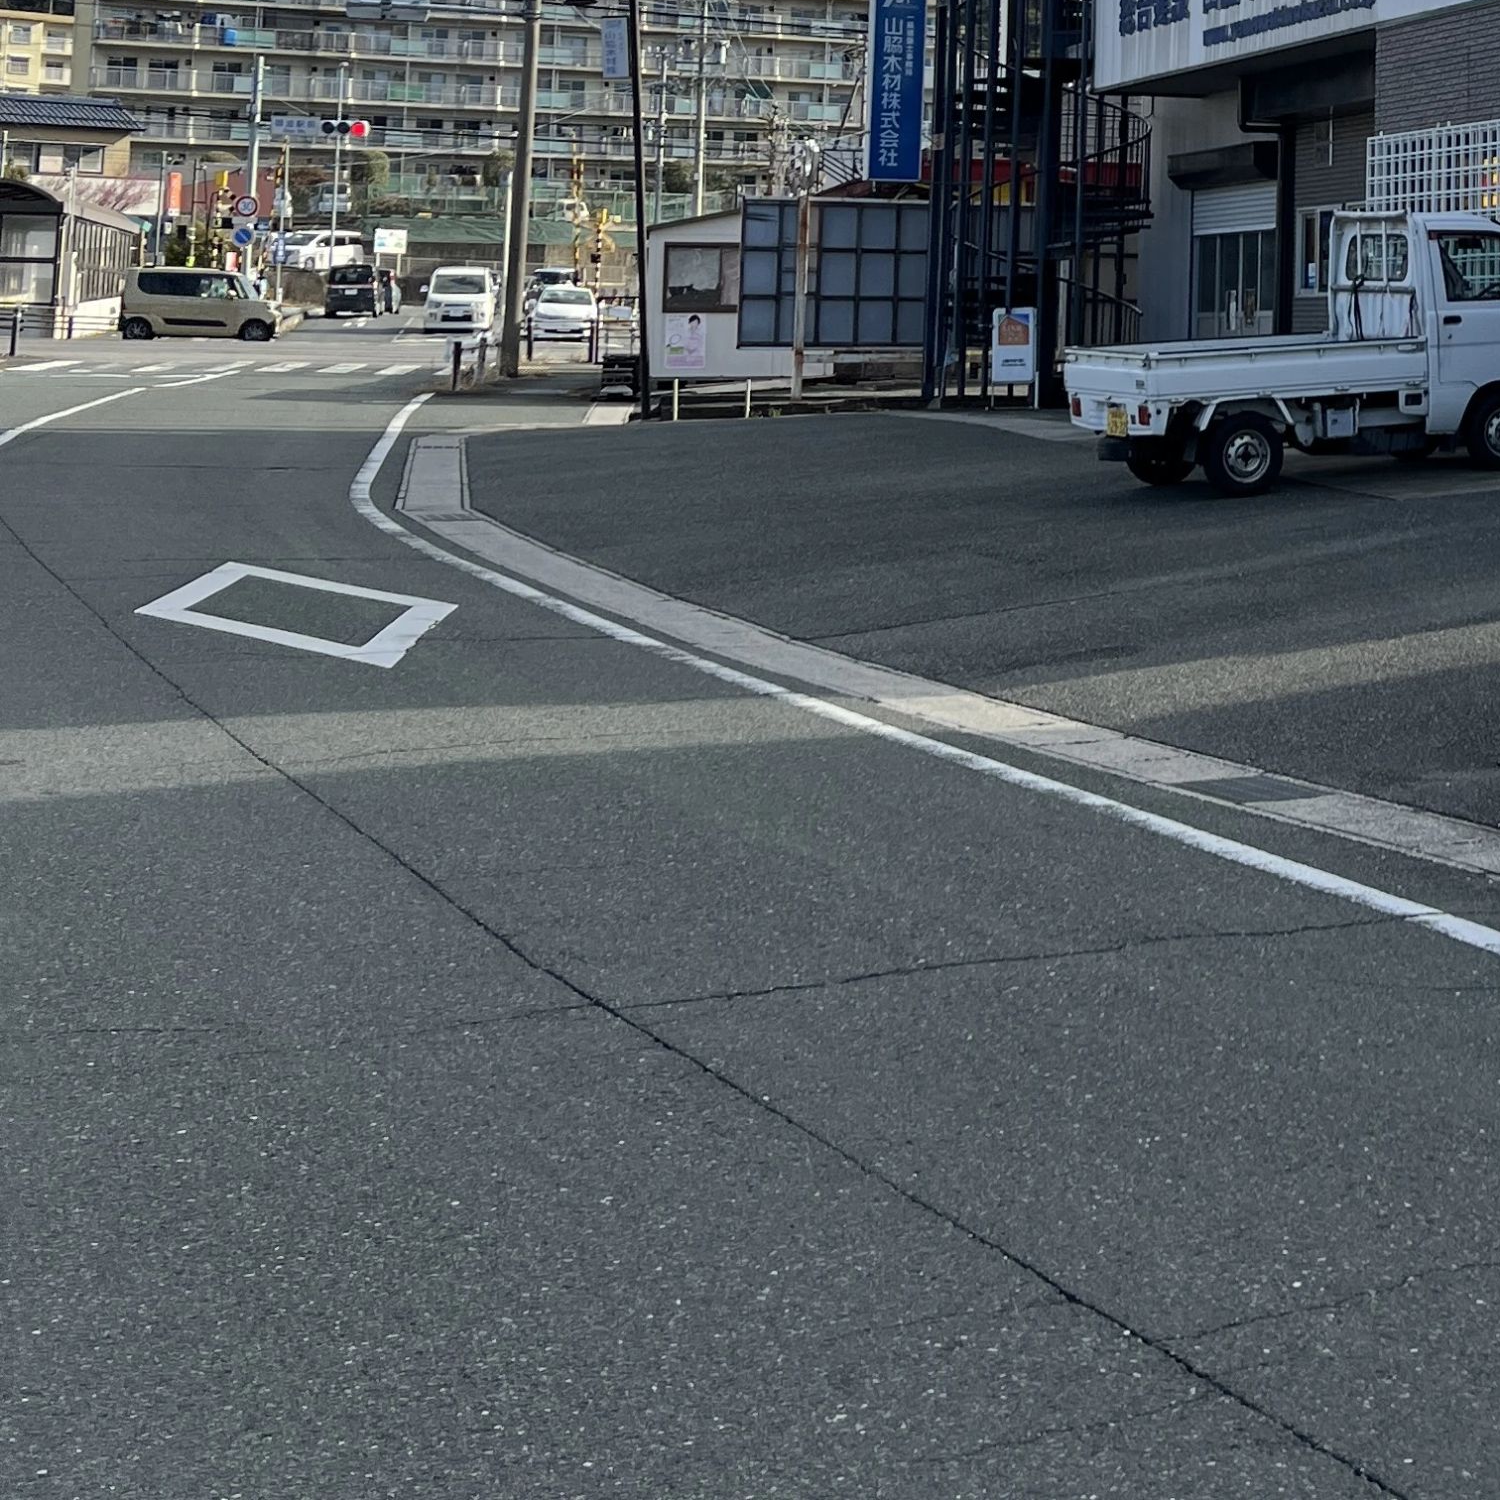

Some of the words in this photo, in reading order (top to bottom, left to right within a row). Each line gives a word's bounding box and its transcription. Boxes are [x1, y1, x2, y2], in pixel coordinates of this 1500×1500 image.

[879, 17, 904, 167] 山脇木材株式会社
[241, 201, 254, 211] 30
